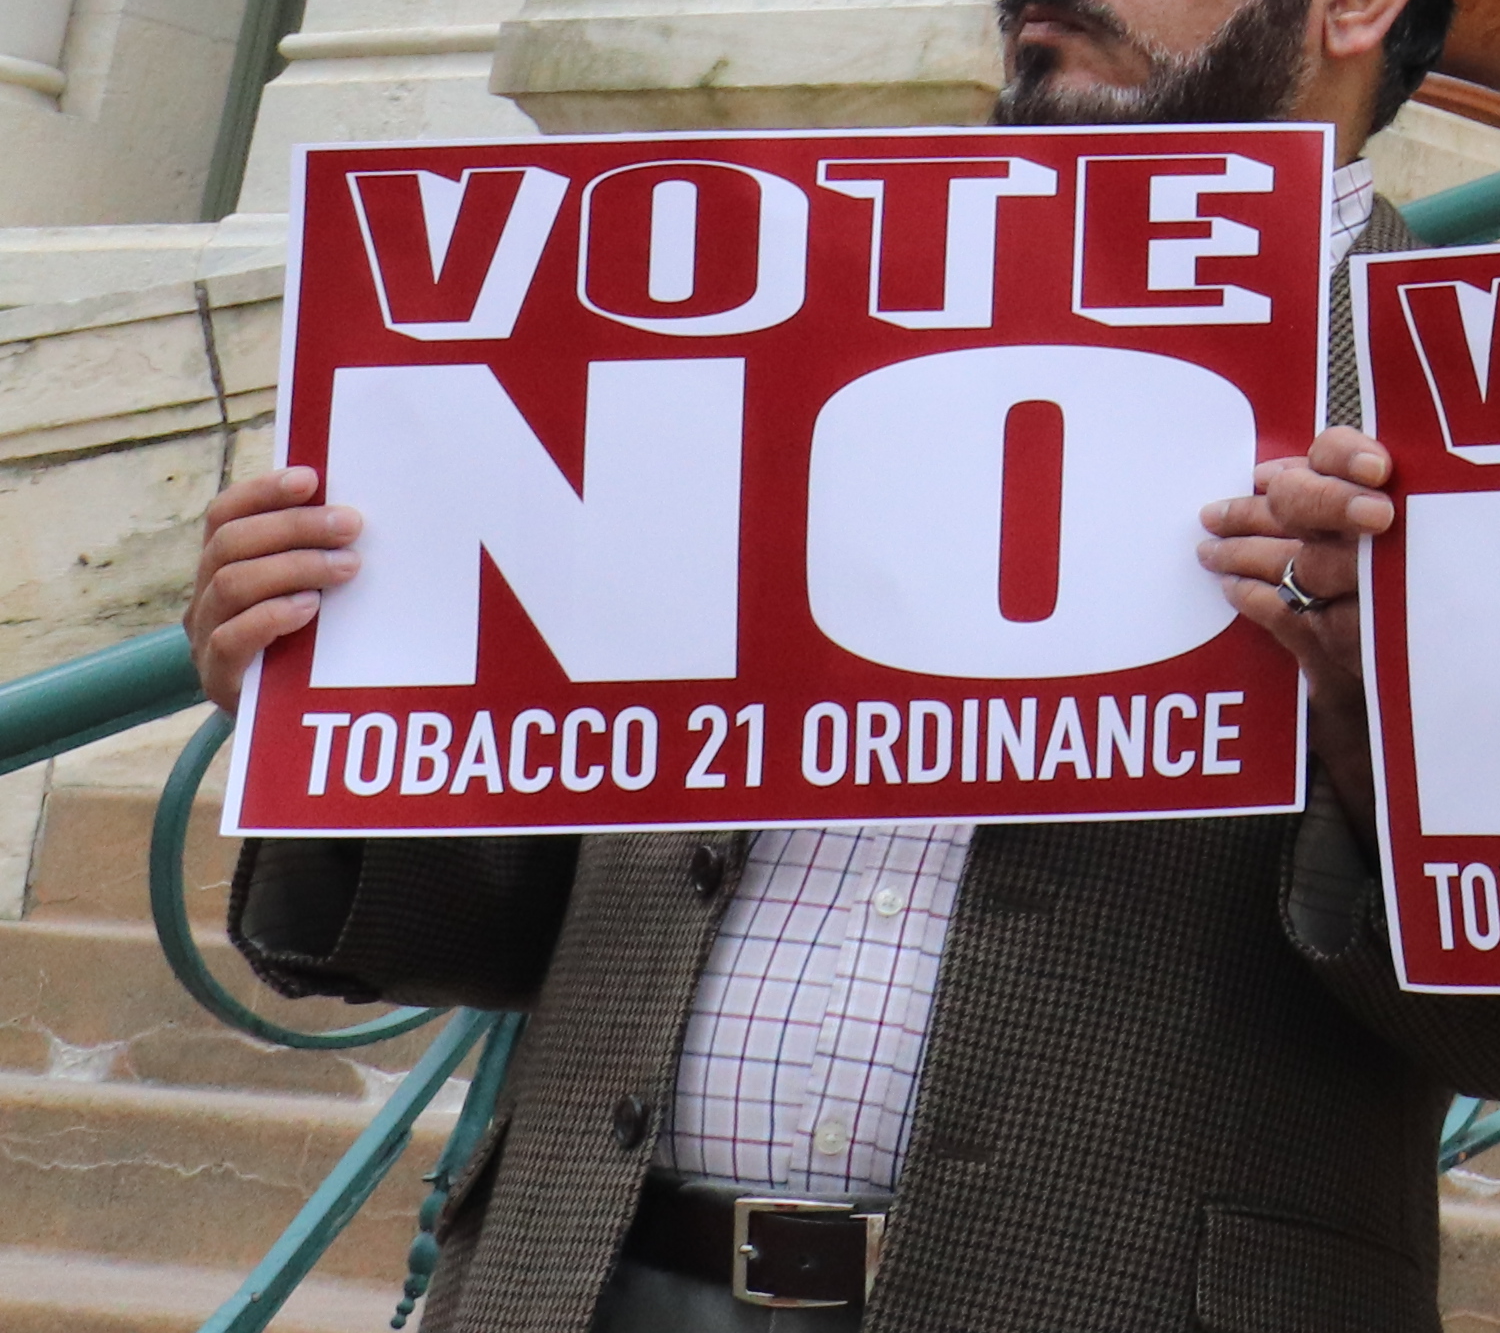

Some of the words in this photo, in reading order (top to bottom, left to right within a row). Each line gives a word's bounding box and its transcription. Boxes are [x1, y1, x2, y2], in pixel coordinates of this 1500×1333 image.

[346, 153, 1274, 341] VOTE
[310, 344, 1257, 689] NO
[301, 703, 659, 798] TOBACCO
[685, 701, 765, 790] 21
[800, 691, 1245, 787] ORDINANCE
